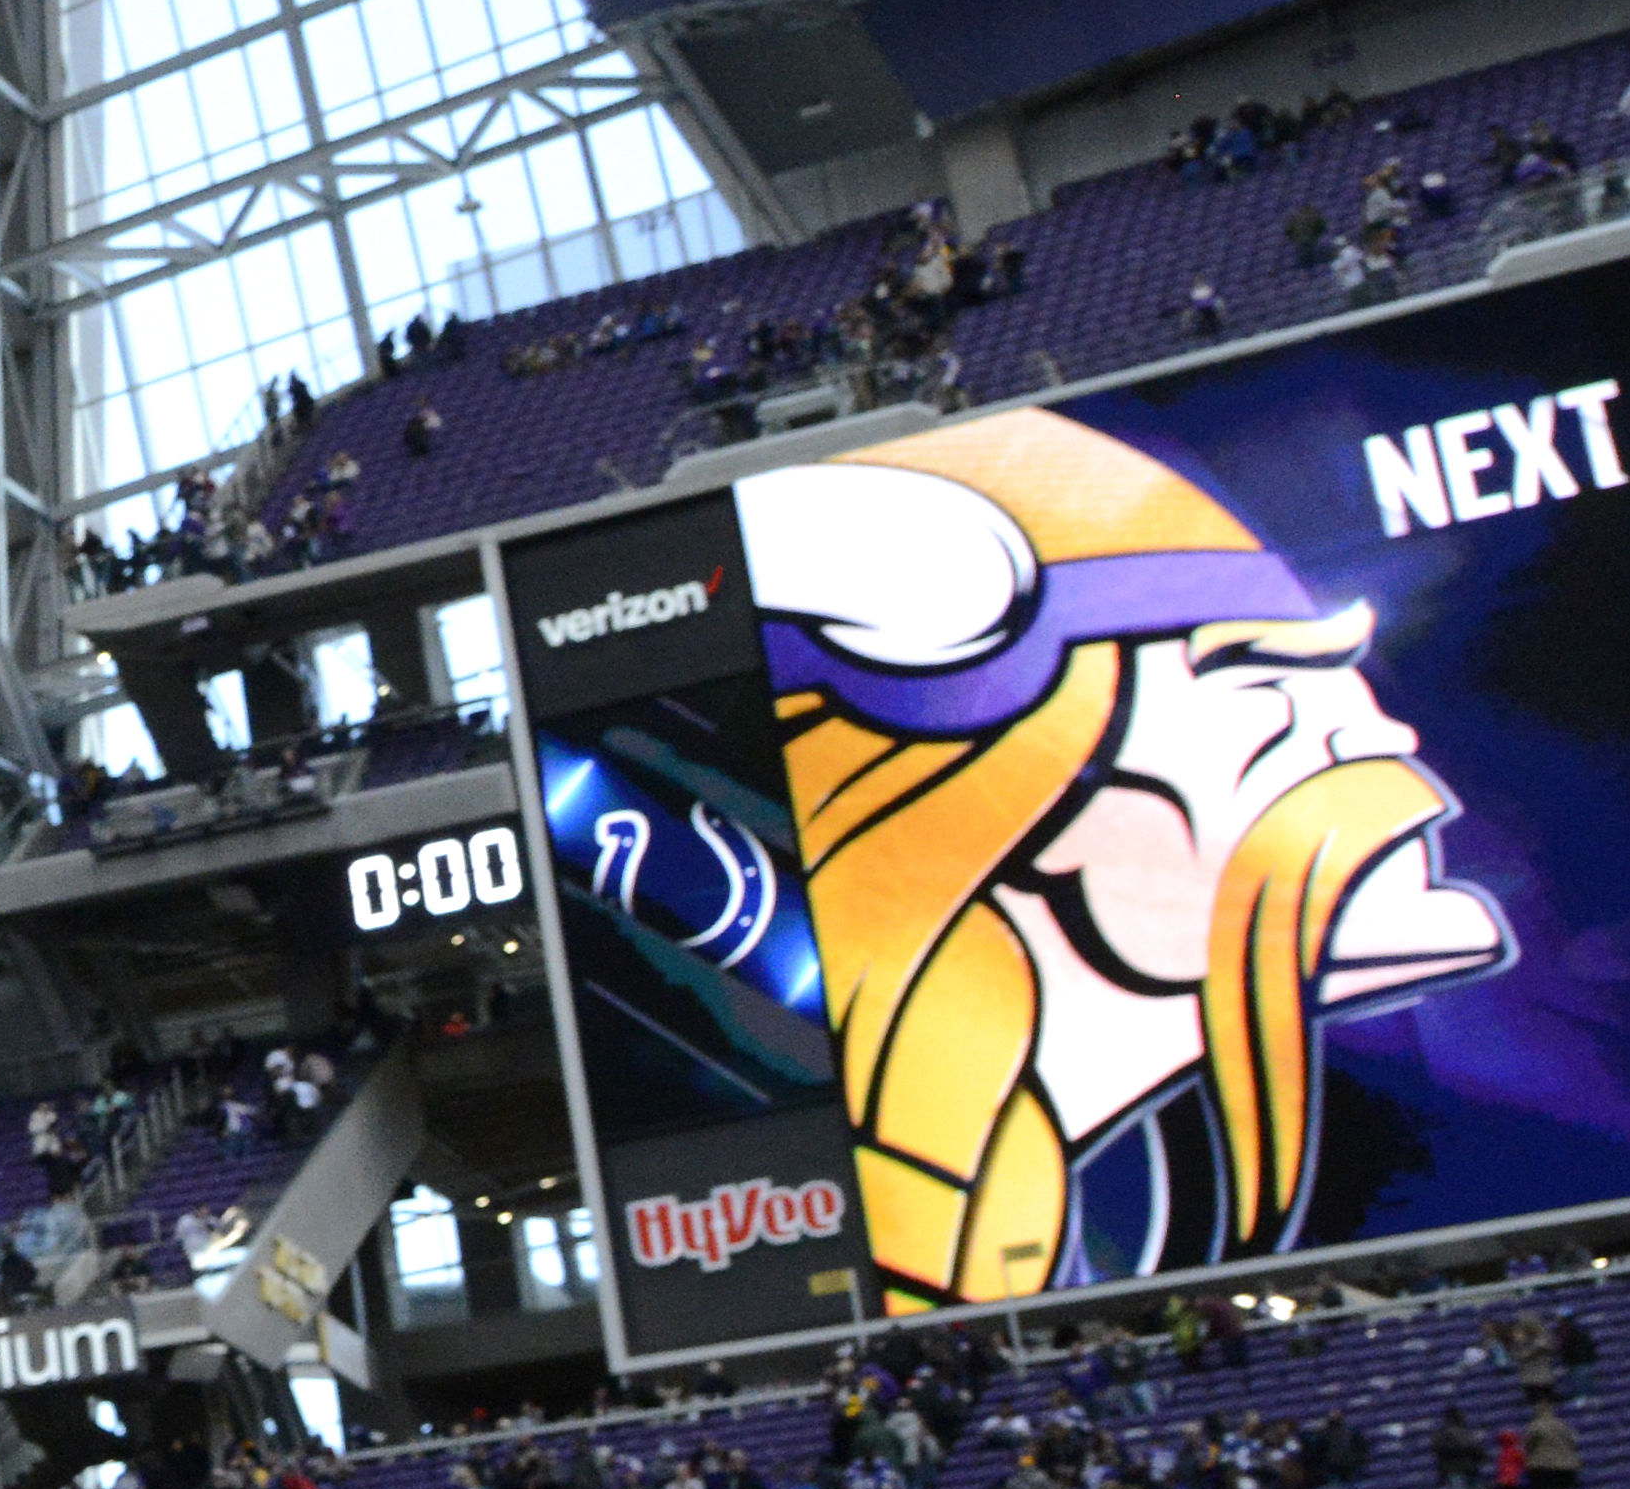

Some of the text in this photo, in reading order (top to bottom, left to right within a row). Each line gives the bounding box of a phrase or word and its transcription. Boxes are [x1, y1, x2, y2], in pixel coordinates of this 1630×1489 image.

[1362, 377, 1630, 539] NEXT
[537, 579, 709, 648] verizon
[348, 827, 523, 931] 0:00
